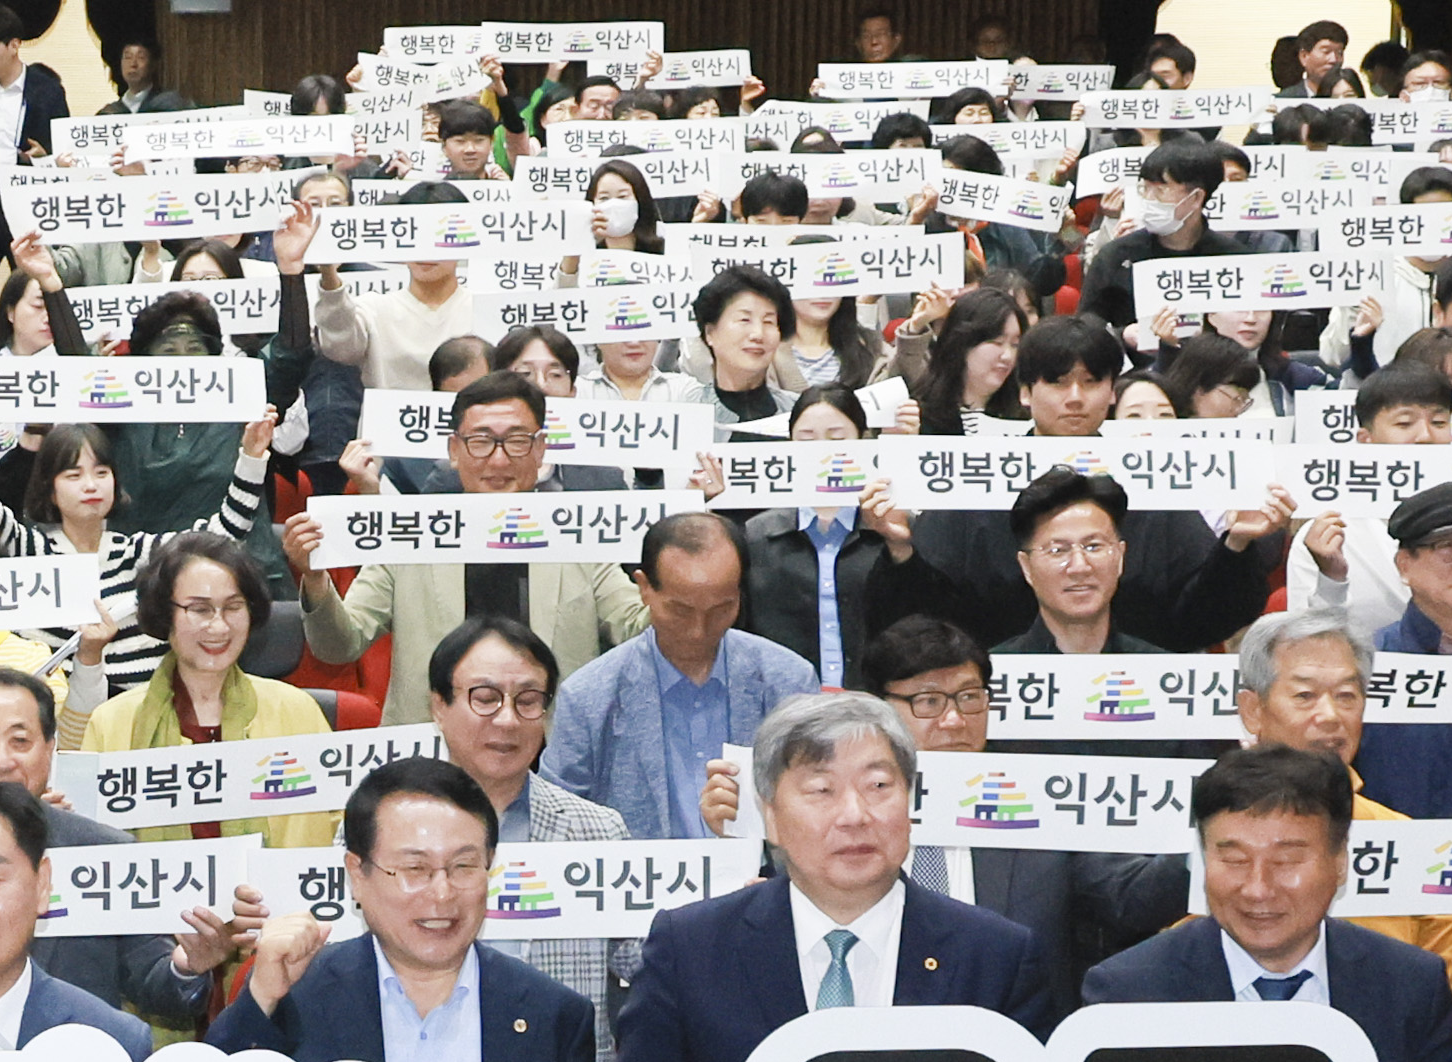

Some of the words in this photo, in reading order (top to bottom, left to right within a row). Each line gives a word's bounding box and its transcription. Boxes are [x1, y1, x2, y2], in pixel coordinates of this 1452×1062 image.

[401, 35, 454, 55] 행복한
[496, 32, 552, 52] 행복한
[596, 30, 650, 50] 익산시
[692, 57, 740, 77] 익산시
[839, 71, 894, 90] 행복한
[935, 67, 989, 86] 익산시
[1066, 70, 1112, 91] 익산시
[1101, 99, 1159, 120] 행복한
[1195, 93, 1251, 116] 익산시
[147, 130, 214, 150] 행복한
[266, 123, 332, 143] 익산시
[565, 130, 627, 152] 행복한
[675, 127, 736, 152] 익산시
[1011, 128, 1070, 151] 익산시
[645, 158, 709, 184] 익산시
[859, 157, 924, 183] 익산시
[32, 194, 125, 231] 행복한
[1281, 189, 1353, 215] 익산시
[331, 217, 417, 250] 행복한
[482, 210, 565, 242] 익산시
[1342, 216, 1424, 247] 행복한
[861, 244, 941, 279] 익산시
[1157, 268, 1243, 301] 행복한
[1310, 260, 1383, 291] 익산시
[501, 300, 588, 332] 행복한
[135, 368, 233, 403] 익산시
[579, 412, 679, 450] 익산시
[919, 452, 1036, 493] 행복한
[1122, 450, 1235, 489] 익산시
[1304, 459, 1424, 502] 행복한
[347, 510, 465, 550] 행복한
[97, 759, 227, 812] 행복한
[1045, 772, 1197, 828] 익산시
[71, 855, 215, 910] 익산시
[564, 856, 712, 912] 익산시
